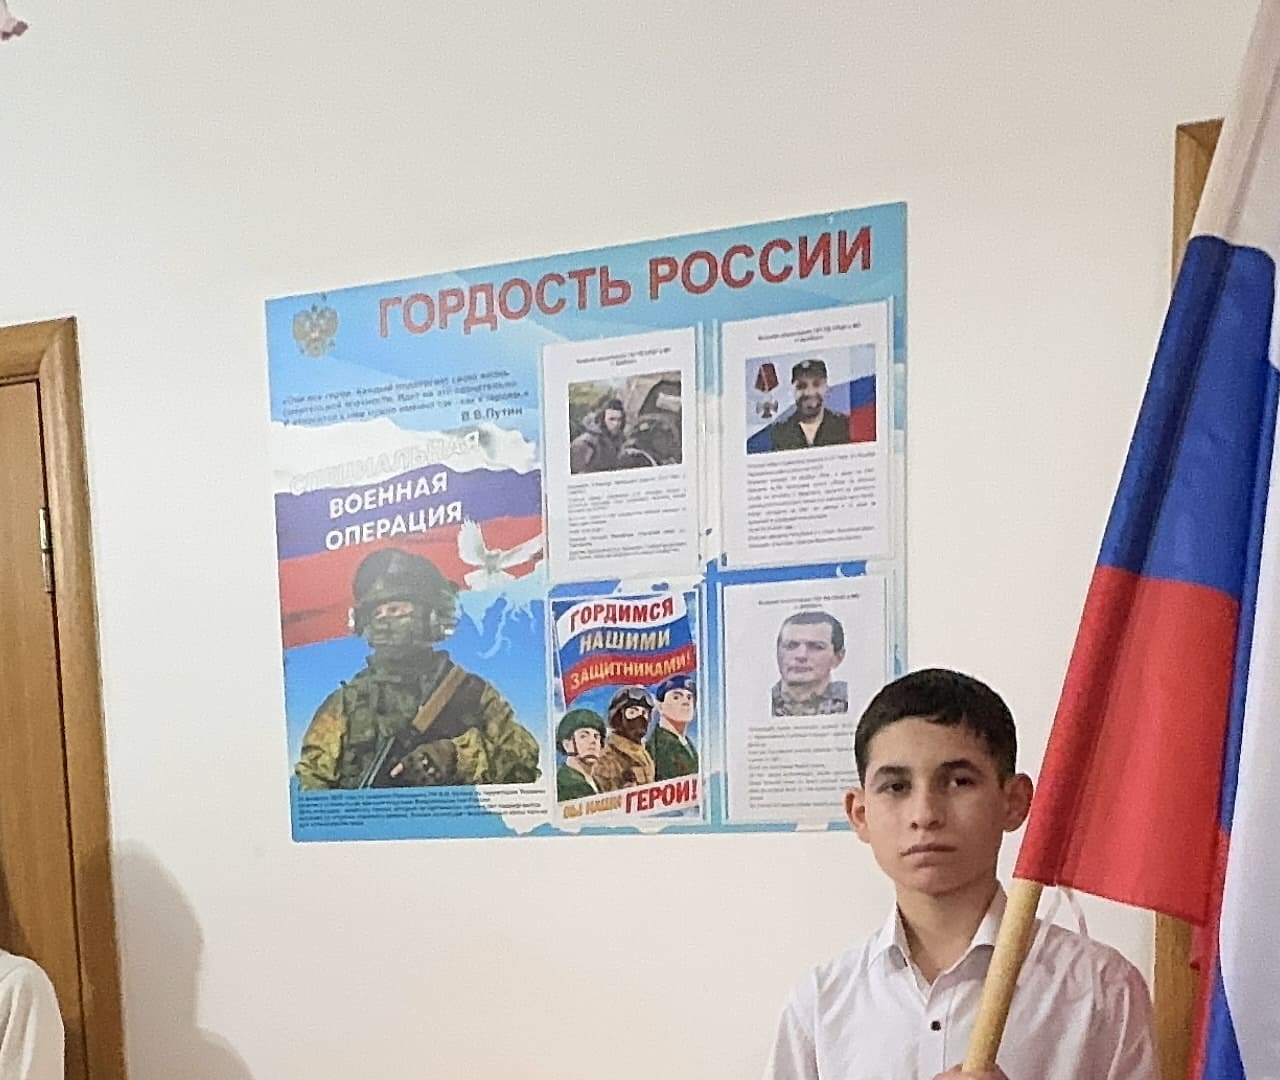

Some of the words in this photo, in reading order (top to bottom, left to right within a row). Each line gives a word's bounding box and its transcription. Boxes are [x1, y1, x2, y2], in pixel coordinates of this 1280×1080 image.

[380, 266, 630, 337] ГОРДОСТЬ
[649, 226, 872, 300] РОССИИ
[329, 471, 448, 519] ВОЕННАЯ
[325, 501, 463, 551] ОПЕРАЦИЯ
[570, 597, 673, 632] ГОРДИМСЯ
[580, 629, 670, 654] НАШИМИ
[570, 653, 691, 690] ЗАЩИТНИКАМИ!
[625, 779, 698, 814] ГЕРОИ!
